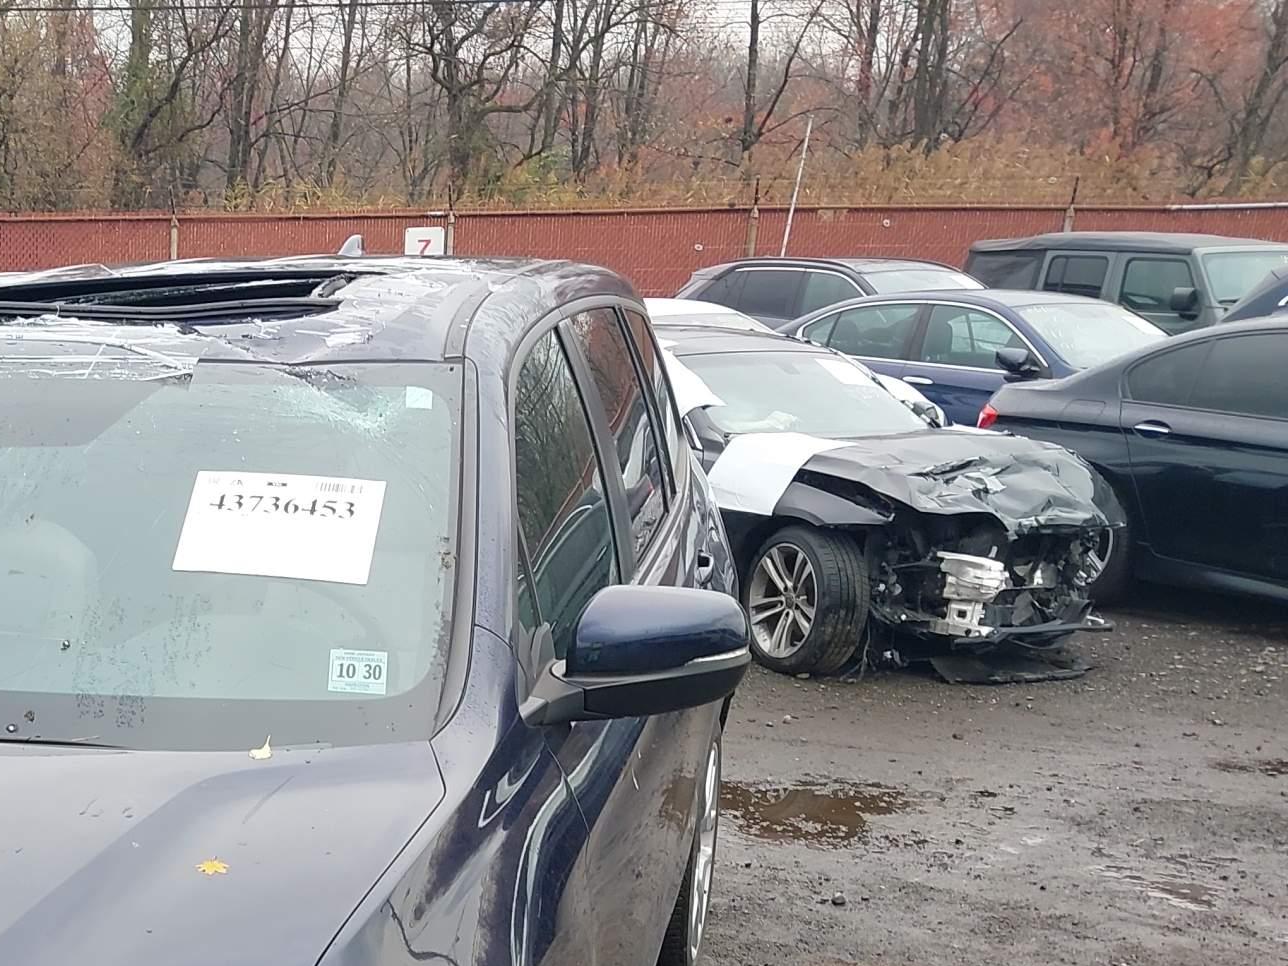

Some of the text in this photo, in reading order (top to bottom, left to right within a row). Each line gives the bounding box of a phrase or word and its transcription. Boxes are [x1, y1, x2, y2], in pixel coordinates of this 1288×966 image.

[417, 239, 432, 256] 7
[209, 493, 356, 519] 43736453
[336, 662, 382, 681] 10 30
